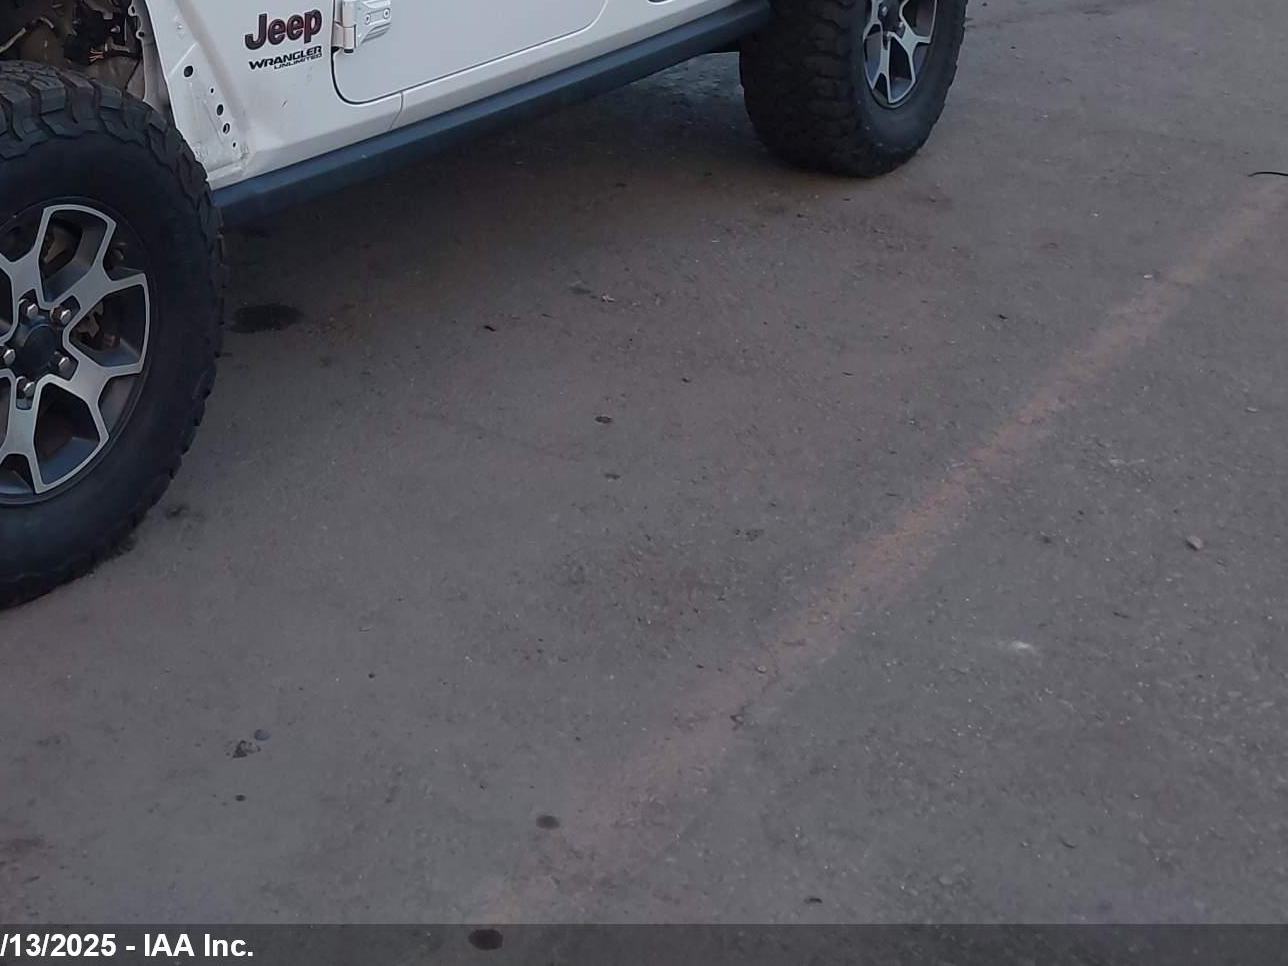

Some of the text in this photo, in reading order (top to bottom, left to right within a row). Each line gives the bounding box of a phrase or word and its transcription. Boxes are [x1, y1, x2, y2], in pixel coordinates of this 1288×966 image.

[245, 9, 322, 50] Jeep
[249, 45, 322, 70] WRANGLER
[273, 52, 323, 70] UNLIMITED
